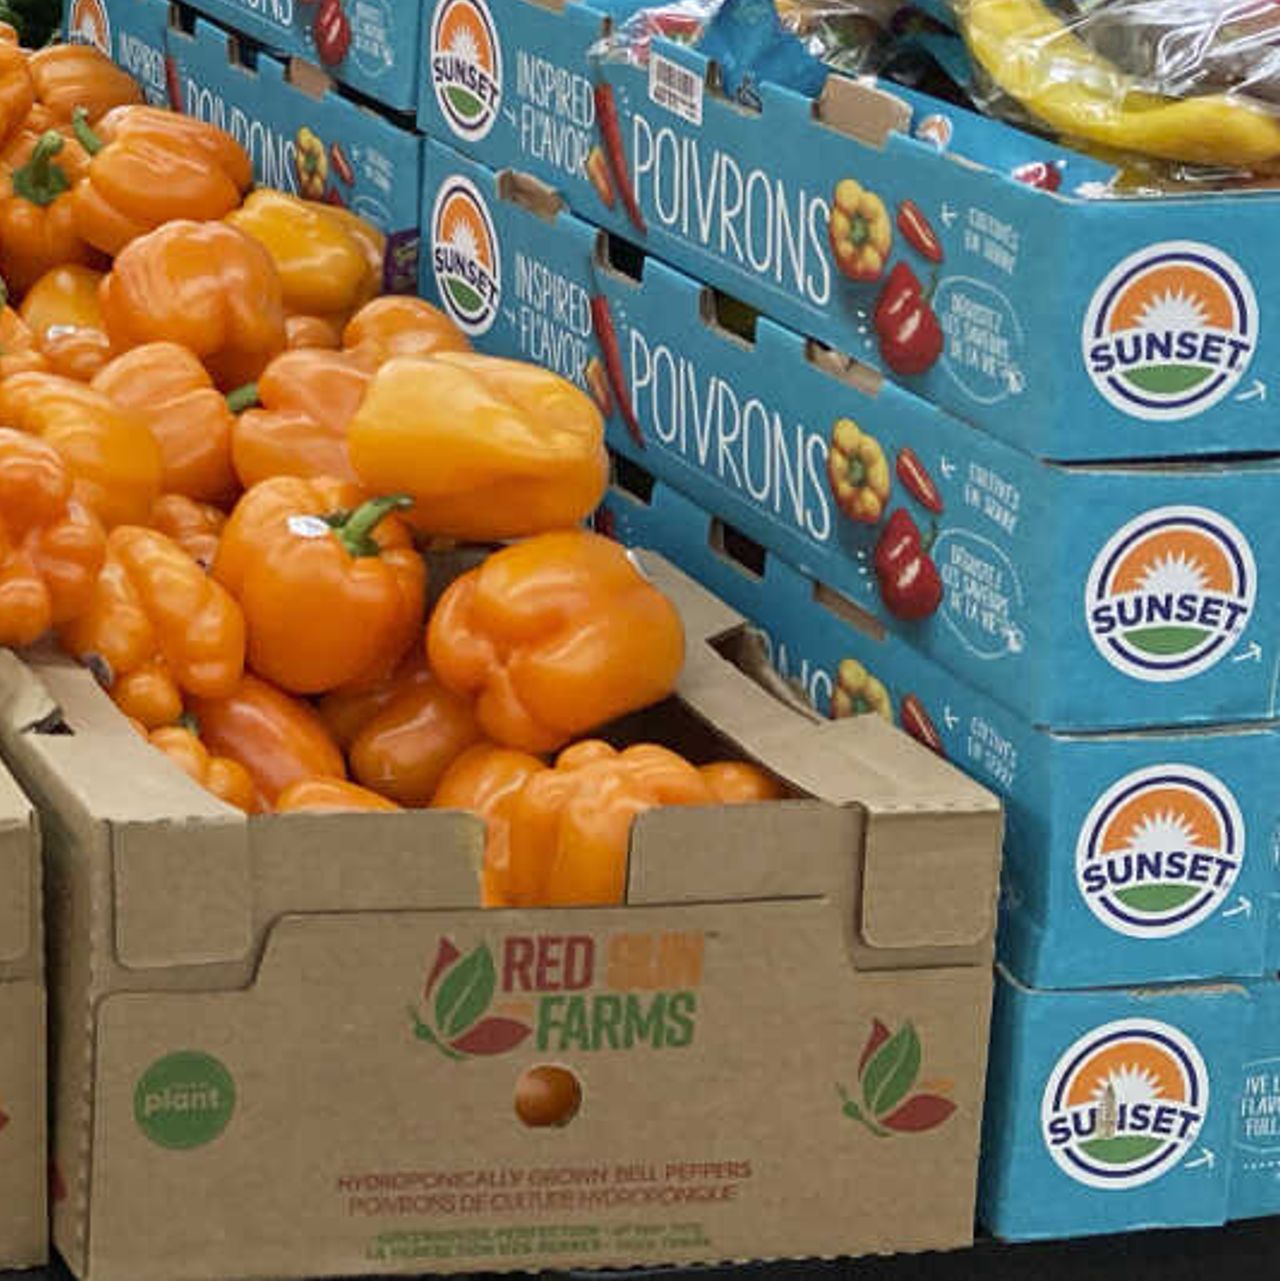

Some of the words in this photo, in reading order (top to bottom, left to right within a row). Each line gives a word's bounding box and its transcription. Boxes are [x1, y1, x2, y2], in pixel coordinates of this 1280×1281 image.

[433, 56, 499, 102] SUNSET
[517, 50, 595, 129] INSPIRED
[520, 103, 591, 182] FLAVOR
[633, 114, 831, 306] POIVRONS
[434, 248, 498, 299] SUNSET
[515, 254, 593, 334] INSPIRED
[519, 309, 588, 387] FLAVOR
[1090, 329, 1250, 373] SUNSET
[630, 329, 830, 543] POIVRONS
[1092, 593, 1248, 635] SUNSET
[1082, 851, 1237, 894] SUNSET
[502, 935, 595, 993] RED
[535, 991, 697, 1052] FARMS
[144, 1087, 222, 1117] plant
